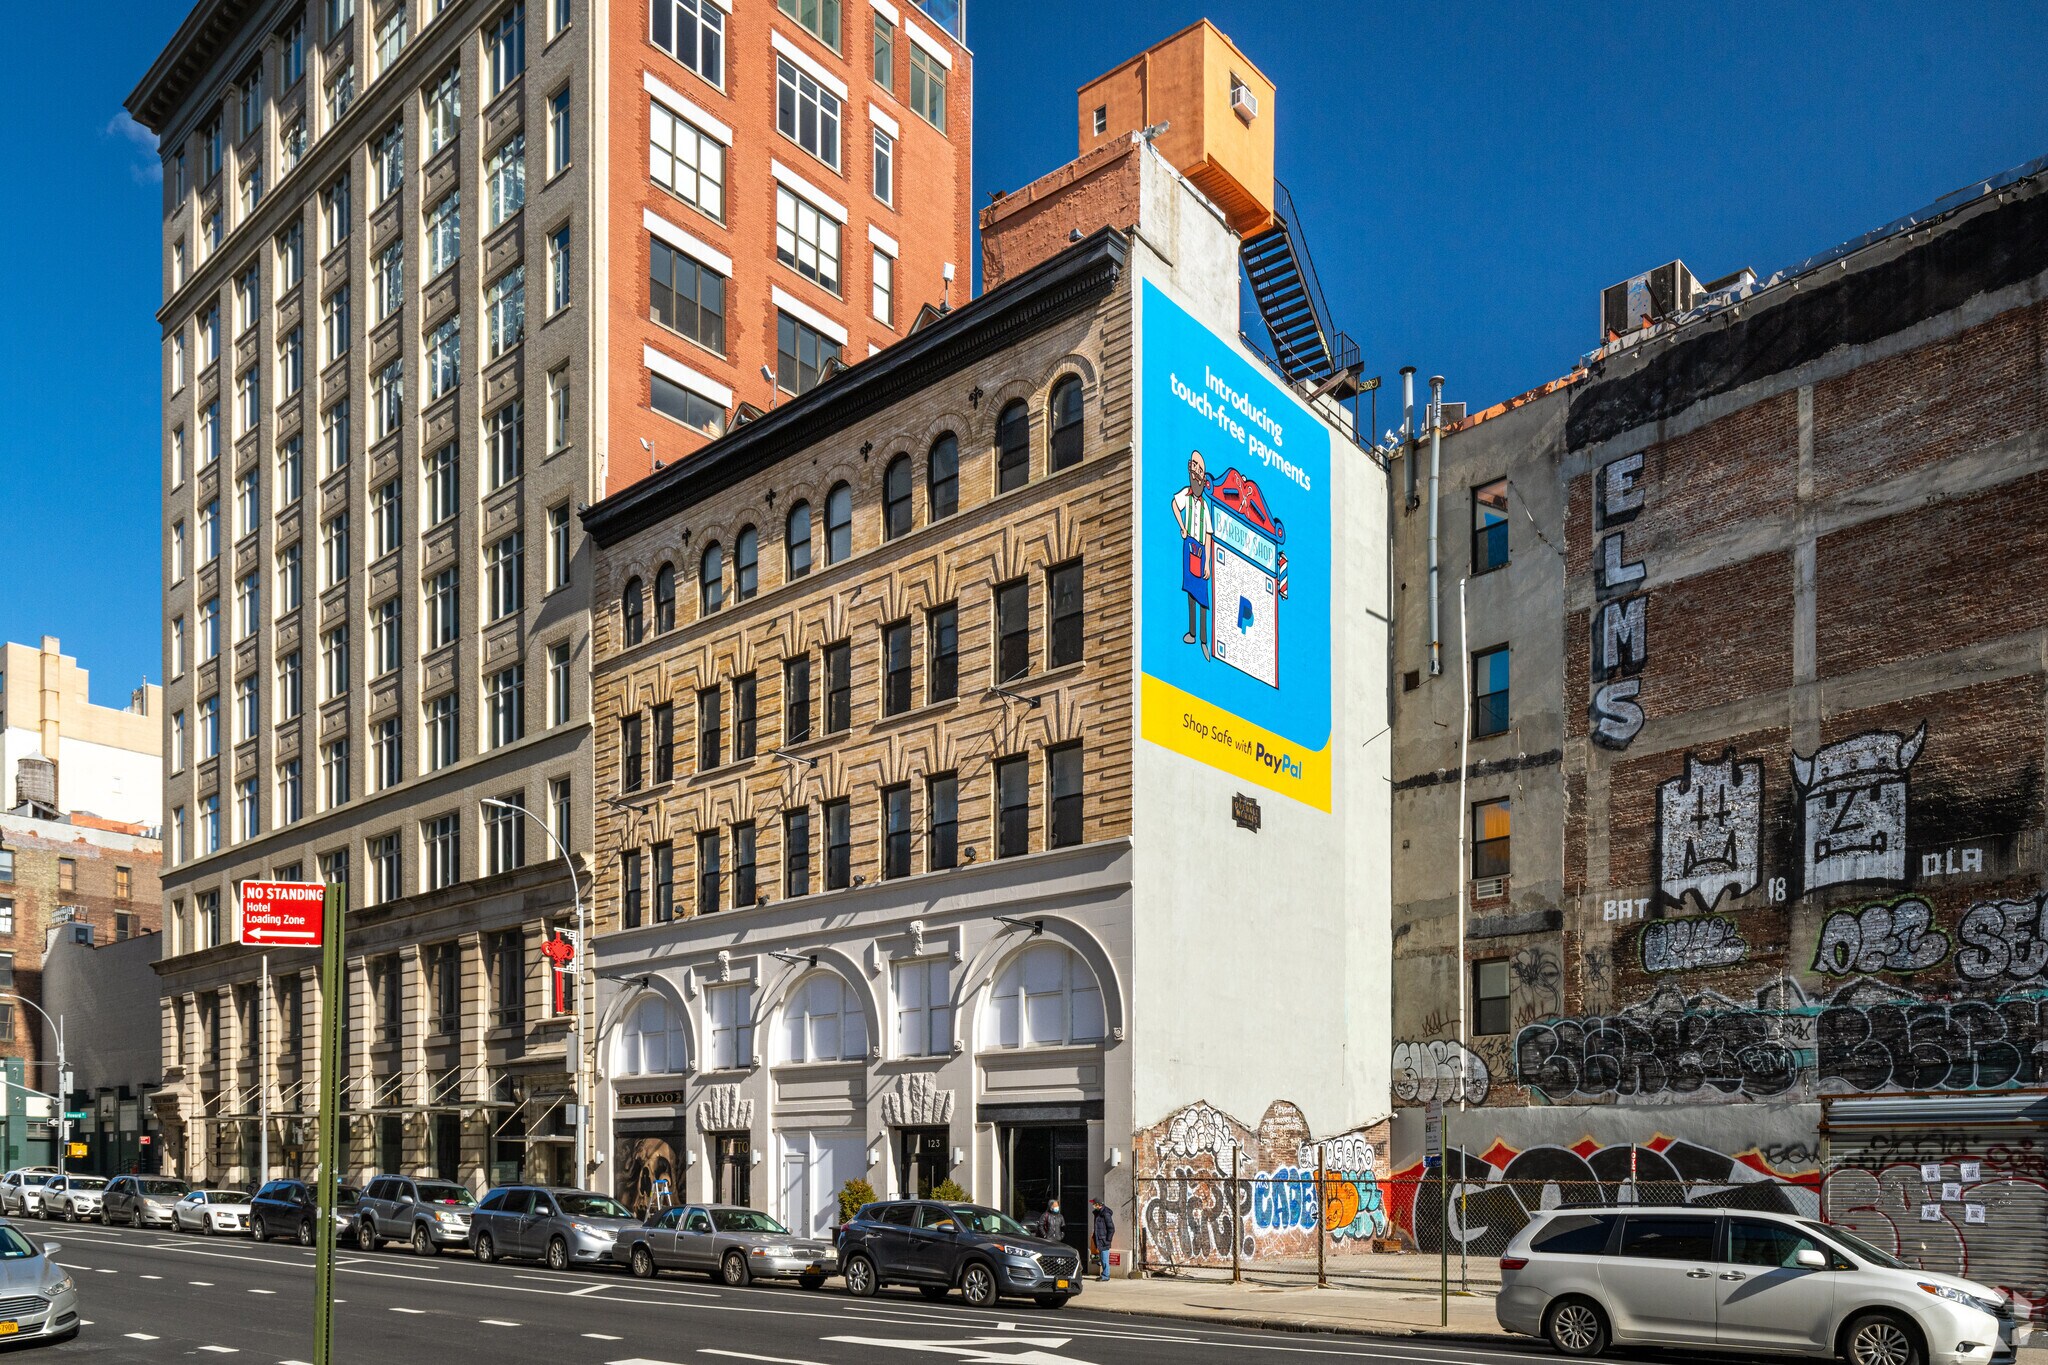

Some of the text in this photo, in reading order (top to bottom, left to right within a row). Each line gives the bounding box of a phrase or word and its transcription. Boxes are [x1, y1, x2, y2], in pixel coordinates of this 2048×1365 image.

[1205, 365, 1283, 447] Introducing
[1169, 372, 1311, 491] touch-free payments
[1216, 512, 1274, 562] BARBER SHOP
[1595, 452, 1646, 740] ELMS
[1182, 713, 1302, 780] Shop Safe with PayPal
[246, 887, 324, 901] NO STANDING
[246, 902, 271, 912] Hotel
[1603, 898, 1650, 922] BAT
[246, 914, 305, 926] Loading Zone
[628, 1093, 674, 1105] TATTOO
[927, 1139, 941, 1148] 123
